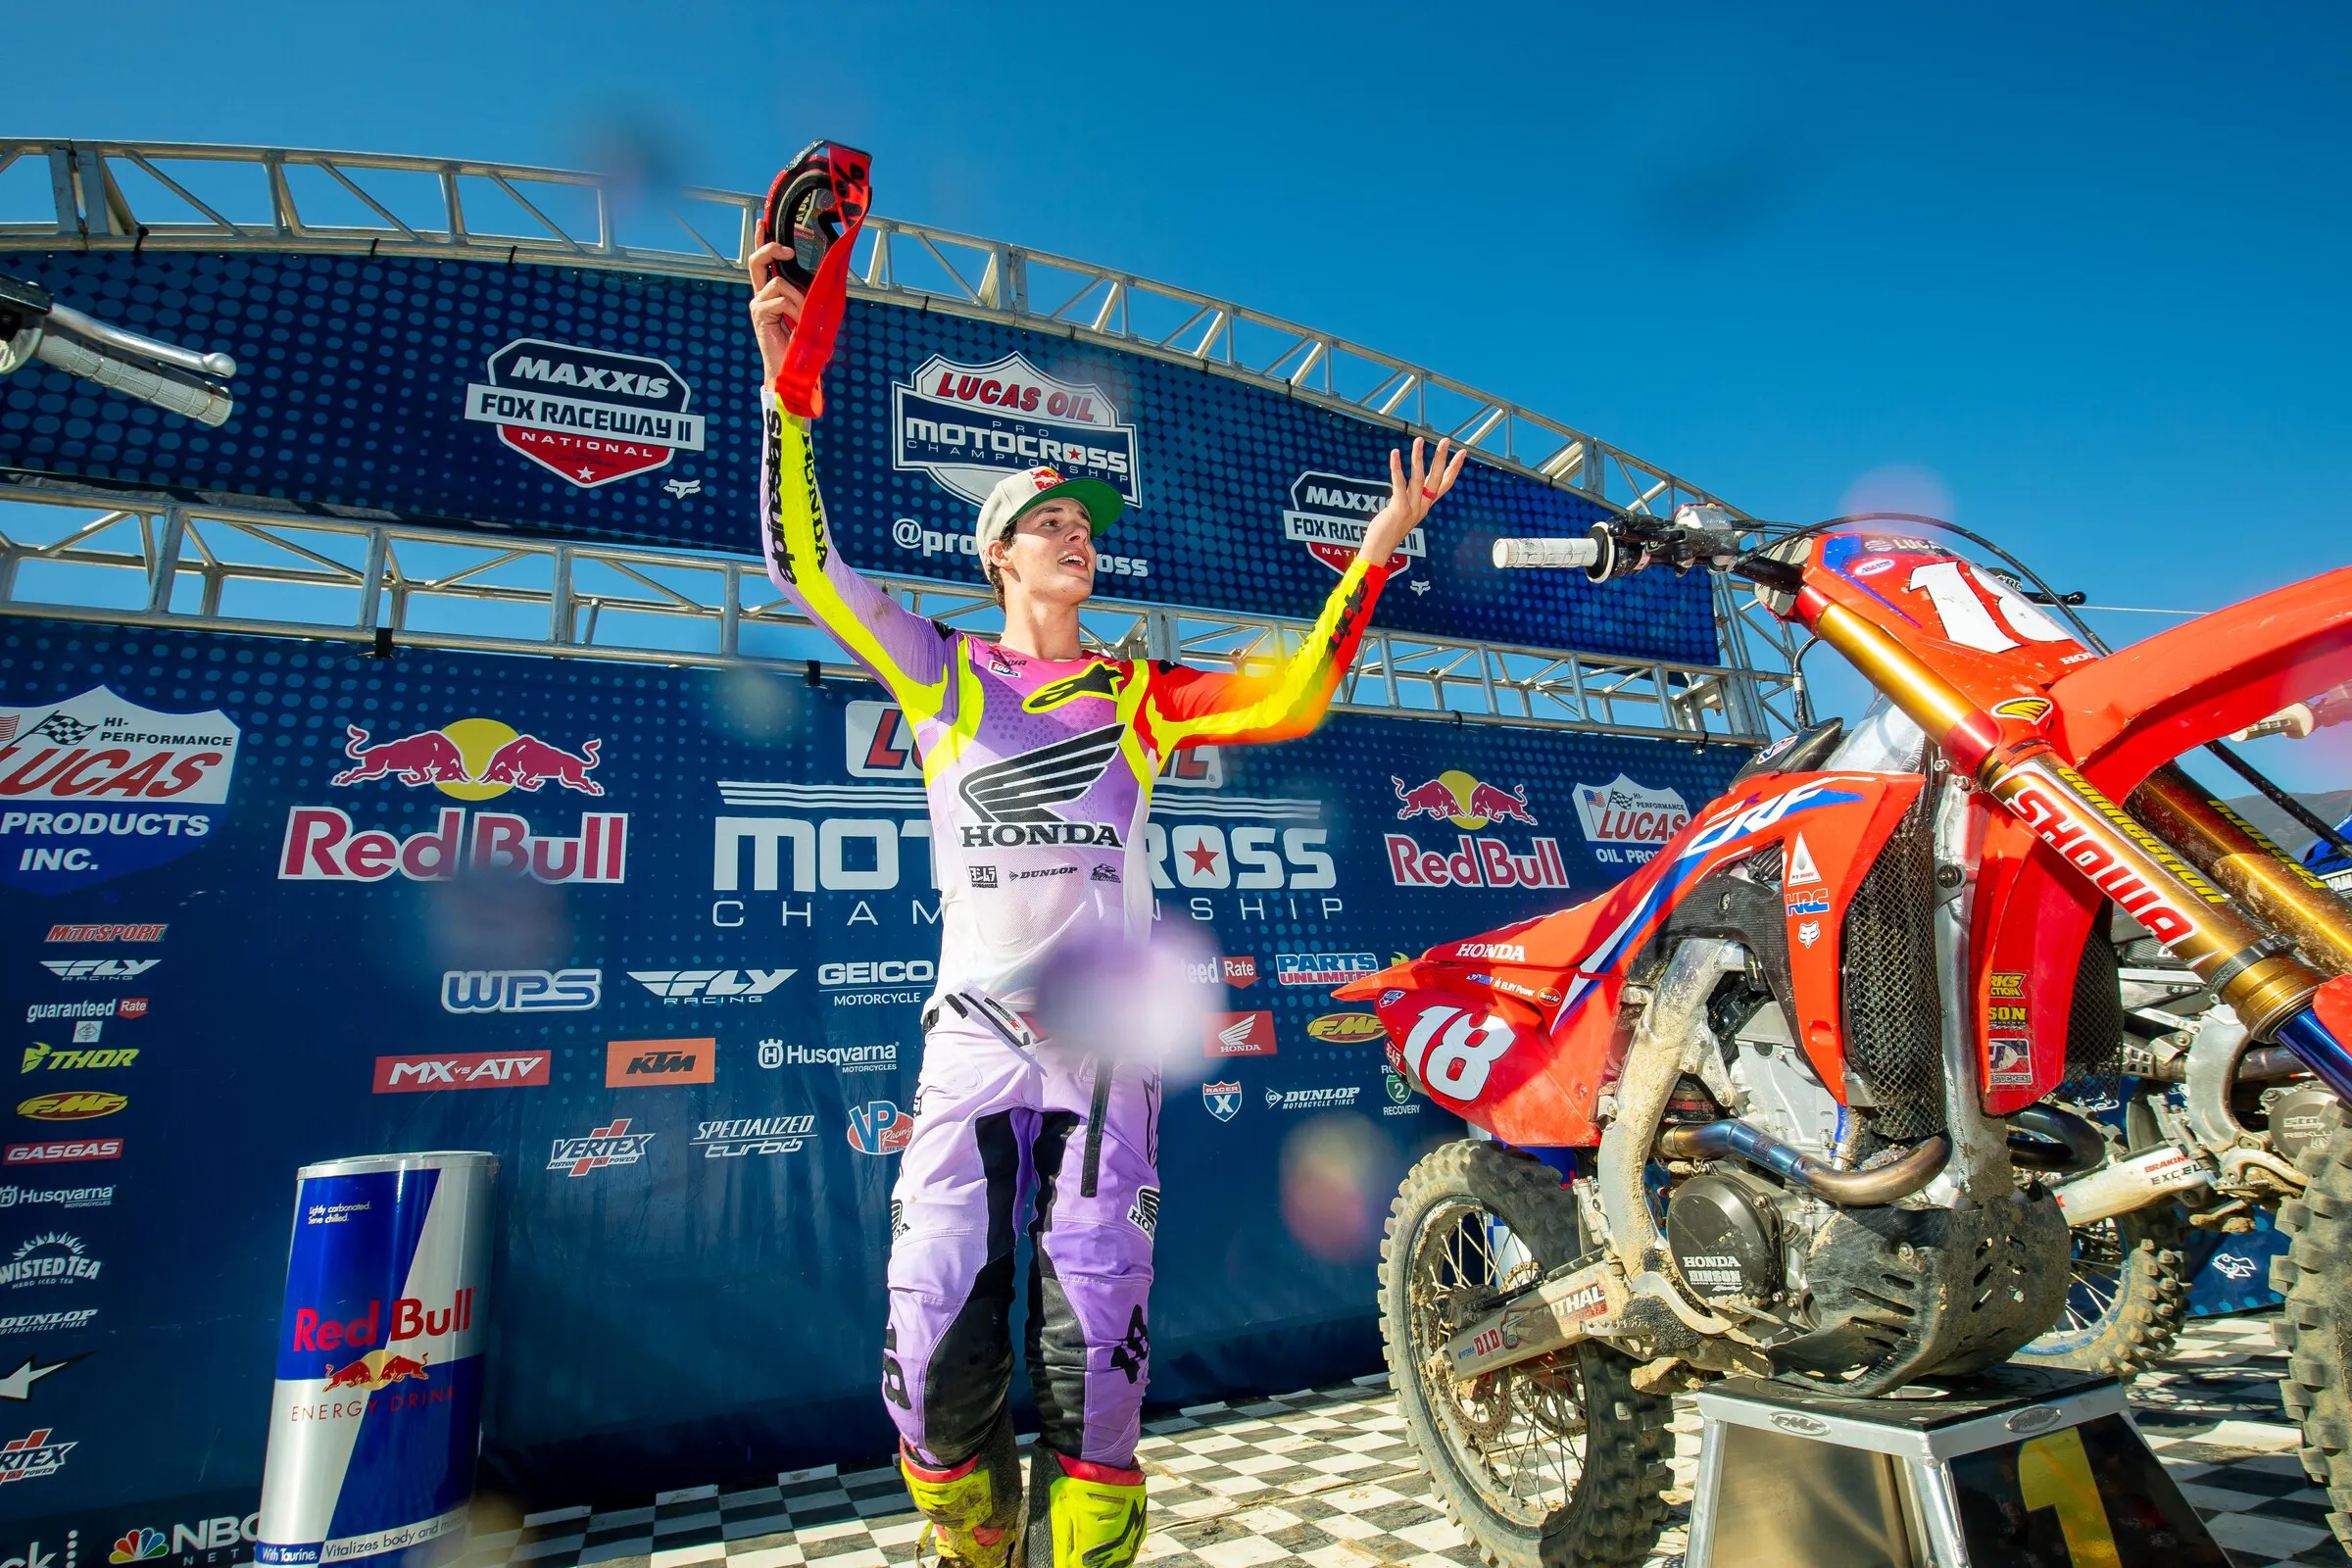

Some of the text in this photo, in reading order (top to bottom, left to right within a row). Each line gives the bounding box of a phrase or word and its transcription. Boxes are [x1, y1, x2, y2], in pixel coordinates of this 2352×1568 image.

[511, 356, 670, 399] MAXXIS
[935, 371, 1095, 422] LUCAS OIL
[481, 393, 692, 442] FOX RACEWAY II
[992, 420, 1050, 437] PRO
[521, 431, 654, 458] NATIONAL
[906, 416, 1128, 473] MOTOCROSS
[906, 439, 1129, 483] CHAMPIONSHIP
[1293, 516, 1325, 539] FOX
[1321, 547, 1399, 564] NATIL
[105, 716, 129, 727] HI-
[100, 730, 233, 747] PERFORMANCE
[0, 747, 223, 798] UCAS
[1636, 801, 1686, 811] PERFORMANCE
[0, 811, 211, 837] PRODUCTS
[1596, 810, 1687, 841] LUCAS
[278, 806, 628, 883] Red Bull
[960, 824, 1125, 848] HONDA
[19, 848, 99, 871] INC.
[713, 816, 1337, 892] MOROSS
[1384, 833, 1570, 890] Red Bull
[1595, 849, 1616, 863] OIL
[2007, 786, 2195, 941] SHOWA
[1020, 866, 1078, 880] DUNLOP
[712, 898, 1343, 927] CHAMSHIP
[1786, 888, 1831, 916] HRC
[1276, 954, 1378, 973] PARTS
[1455, 943, 1526, 961] HONDA
[817, 959, 935, 985] GEICO
[1224, 959, 1254, 978] Rate
[1279, 971, 1379, 984] UNLIMITE
[441, 968, 602, 1013] WPS
[663, 996, 762, 1005] RACING
[834, 992, 921, 1006] MOTORCYCLE
[26, 999, 147, 1022] guaranteed Rate
[1308, 1014, 1387, 1037] FMF
[47, 1049, 140, 1070] THOR
[787, 1044, 898, 1066] Husqvarna
[1220, 1044, 1261, 1054] HONDA
[1402, 1005, 1517, 1102] 18
[389, 1060, 458, 1085] MX
[466, 1056, 544, 1082] ATV
[626, 1051, 696, 1075] KTM
[841, 1063, 898, 1074] MOTORCYCLES
[1284, 1087, 1361, 1102] DUNLOP
[1394, 1082, 1406, 1099] 2
[17, 1095, 128, 1115] FMF
[1213, 1095, 1234, 1114] X
[1282, 1100, 1331, 1109] MOTORCYCLE
[1383, 1104, 1420, 1116] RECOVERY
[696, 1114, 815, 1141] SPECIALIZED
[848, 1100, 898, 1154] VP
[8, 1142, 120, 1161] GASGAS
[553, 1136, 650, 1161] VERTEX
[705, 1138, 804, 1158] turbo
[550, 1155, 637, 1168] PISTON POWER
[2150, 1162, 2206, 1186] EXCEL
[20, 1186, 113, 1204] Husqvarna
[66, 1255, 102, 1280] TEA
[1682, 1255, 1742, 1268] HONDA
[12, 1280, 34, 1290] HARD
[0, 1308, 98, 1329] DUNLOP
[60, 1320, 88, 1329] TIRES
[294, 1287, 473, 1351] Red Bull
[1473, 1328, 1500, 1357] D.I.D
[291, 1386, 456, 1422] ENERGY DRINK
[280, 1548, 318, 1563] Taurine.
[325, 1539, 379, 1558] Vitalizes
[383, 1527, 416, 1548] body
[418, 1521, 439, 1539] and
